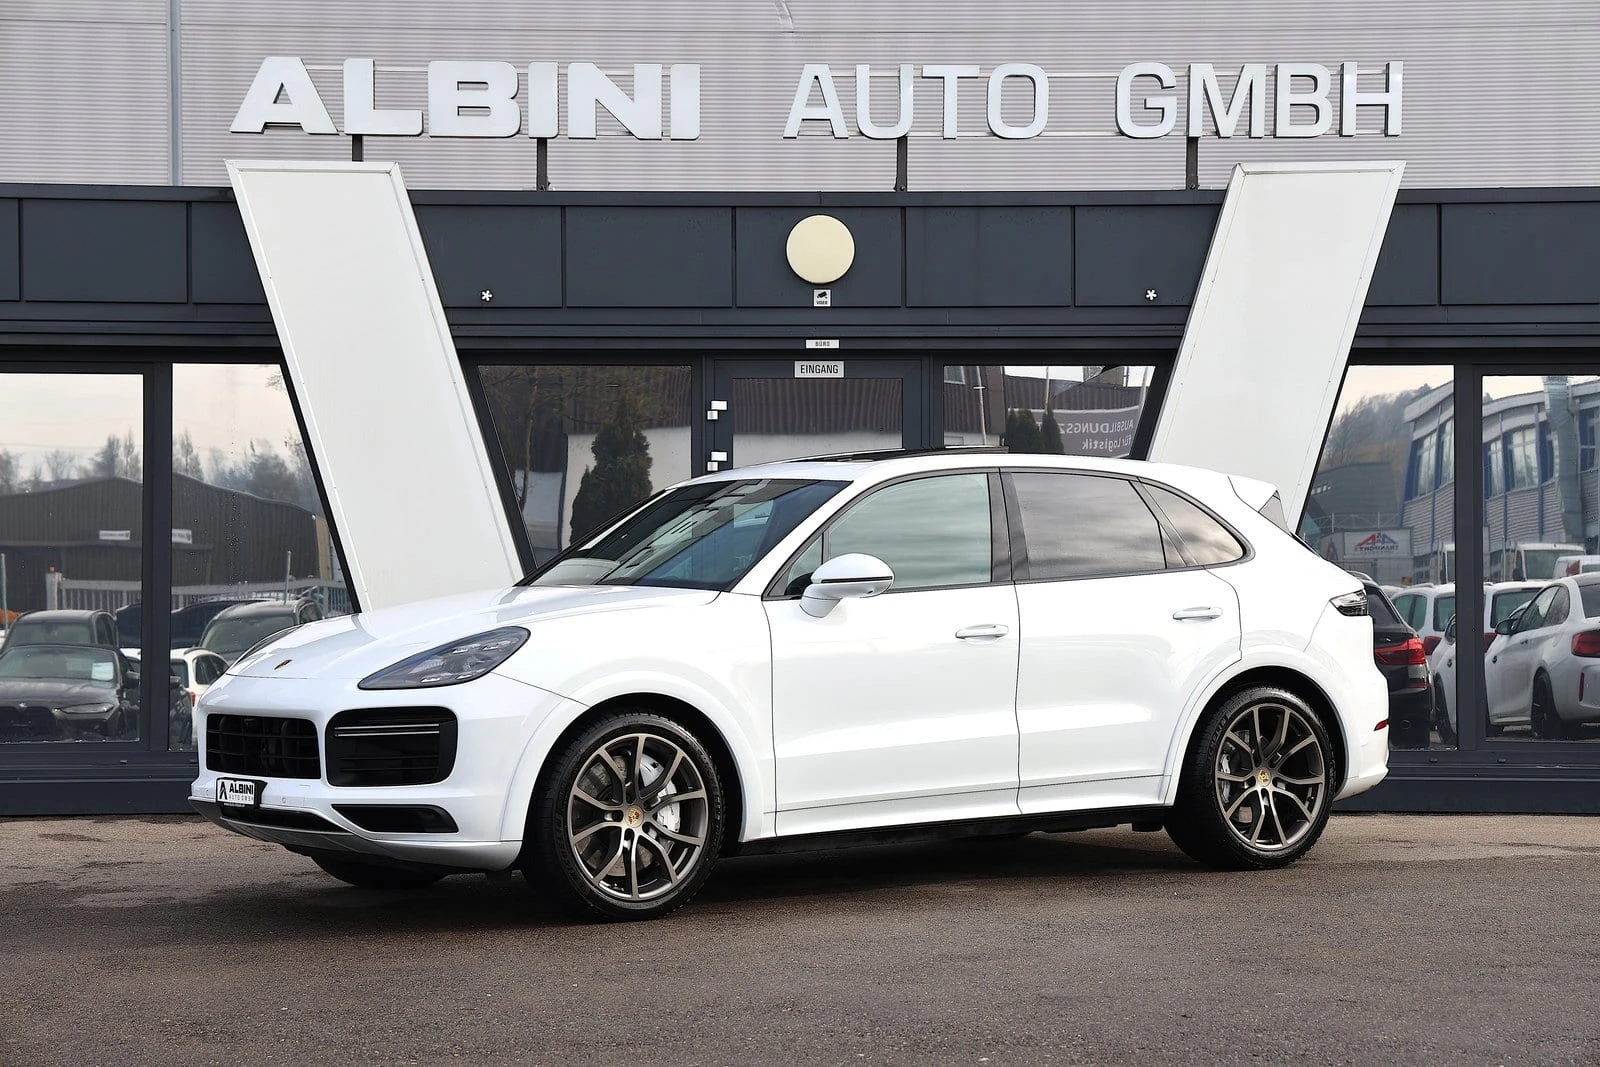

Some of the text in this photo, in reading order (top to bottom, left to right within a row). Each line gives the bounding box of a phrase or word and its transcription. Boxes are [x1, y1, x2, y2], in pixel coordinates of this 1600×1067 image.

[230, 56, 1403, 140] ALBINI AUTO GMBH
[800, 364, 839, 374] EINGANG
[229, 783, 253, 794] ALBINI
